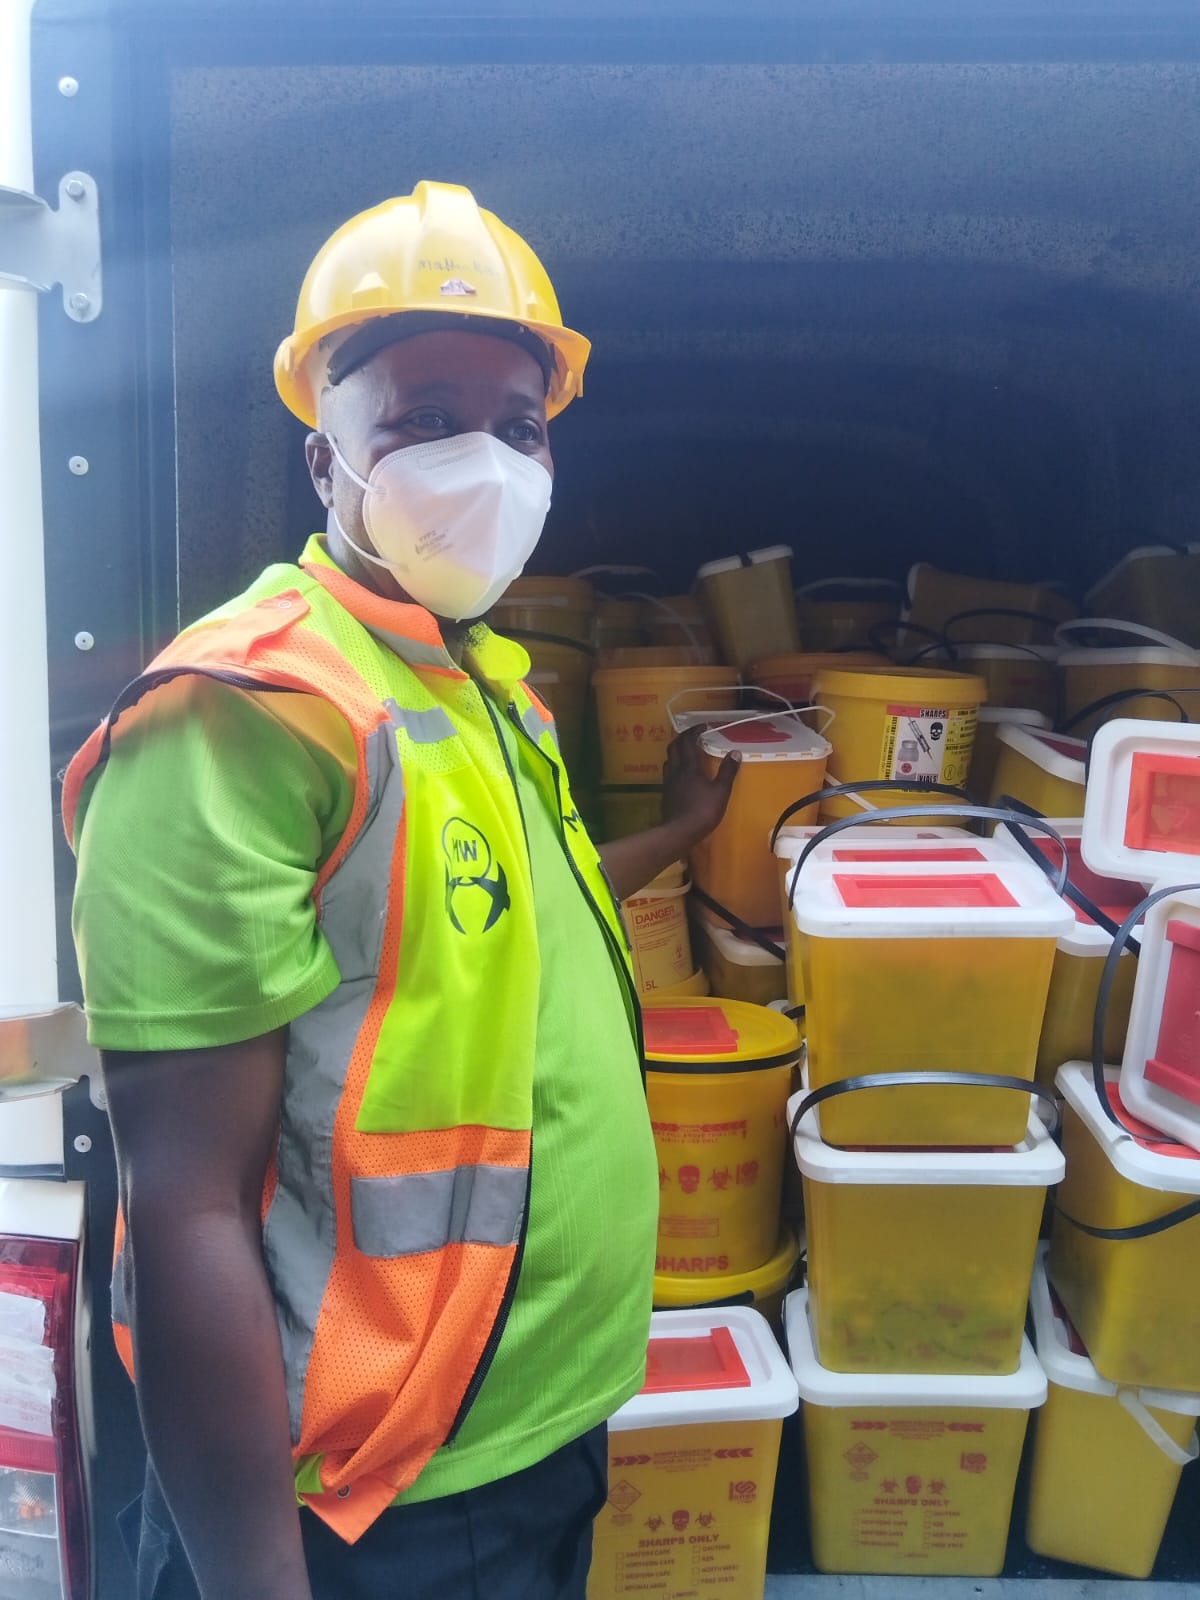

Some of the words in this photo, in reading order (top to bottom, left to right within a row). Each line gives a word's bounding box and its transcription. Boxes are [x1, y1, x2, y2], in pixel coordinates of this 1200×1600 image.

[920, 709, 946, 718] SHARPS
[635, 905, 675, 925] DANGER
[645, 980, 658, 991] 5L
[655, 1255, 729, 1272] SHARPS
[639, 1537, 684, 1548] SHARPS
[689, 1534, 720, 1545] ONLY
